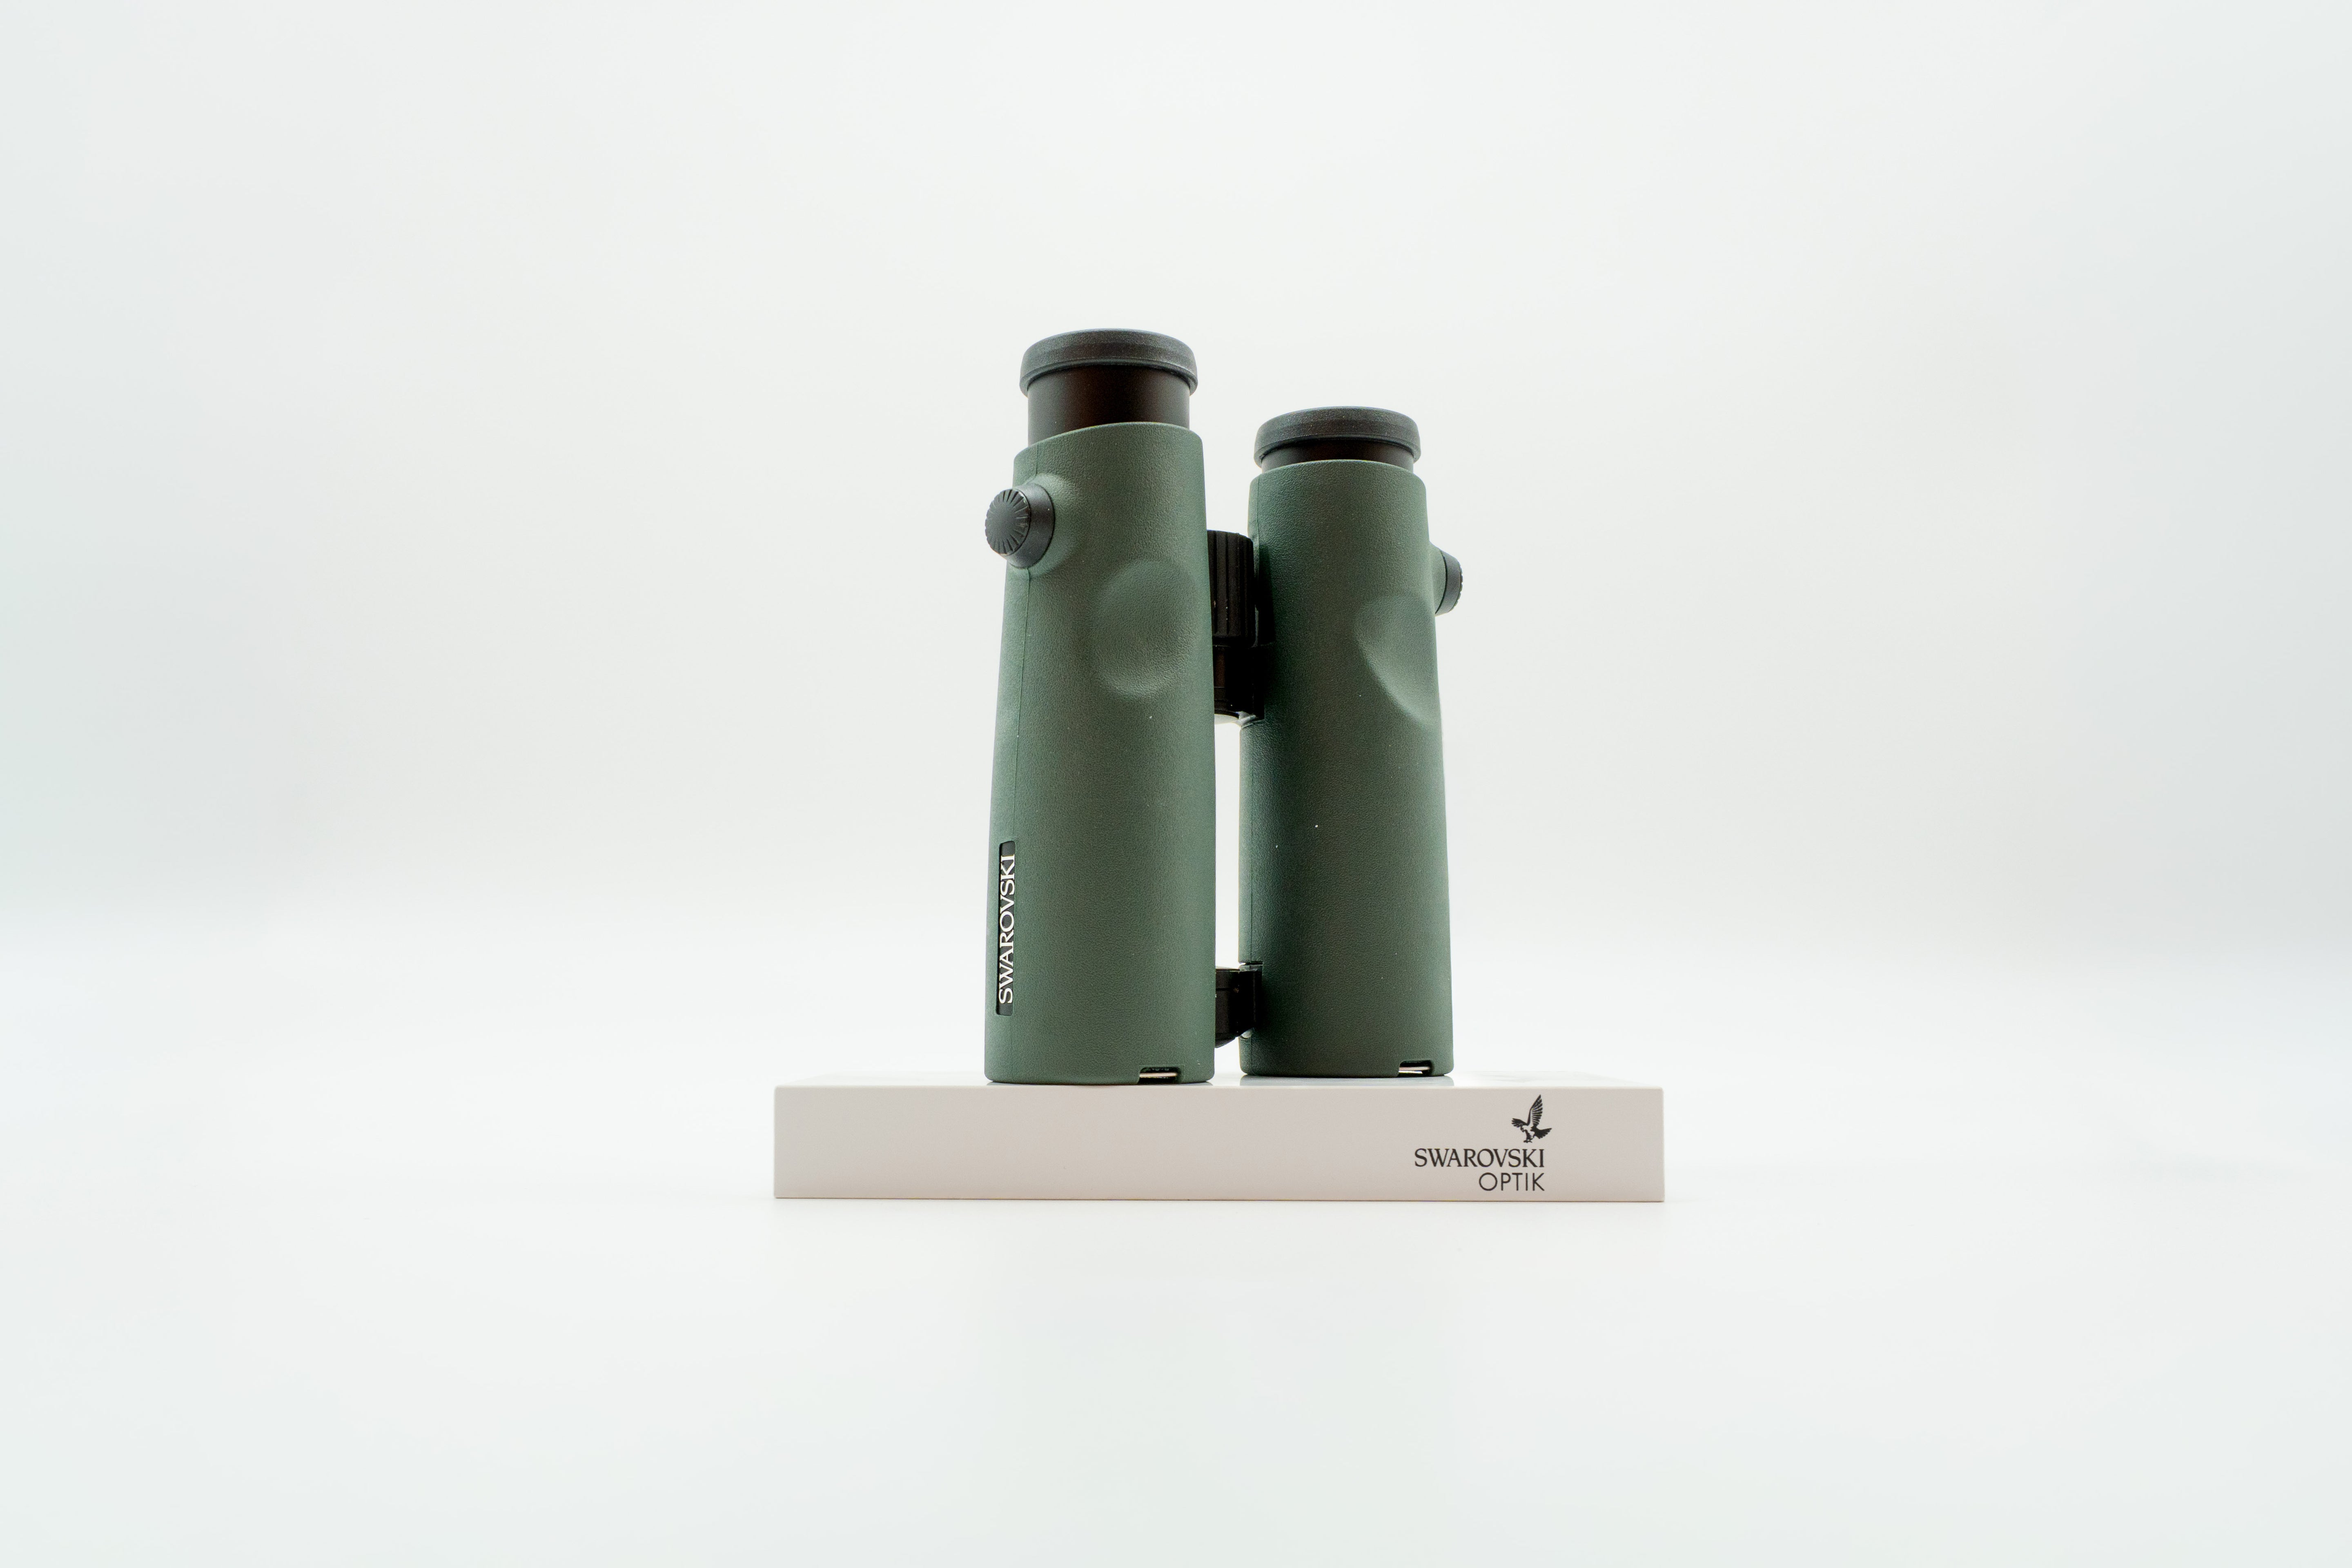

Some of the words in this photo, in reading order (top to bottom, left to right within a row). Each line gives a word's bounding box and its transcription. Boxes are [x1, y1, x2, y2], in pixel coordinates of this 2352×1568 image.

[998, 854, 1015, 1004] SWAROVSKI
[1414, 1148, 1544, 1167] SWAROVSKI
[1479, 1172, 1545, 1191] OPTIK
